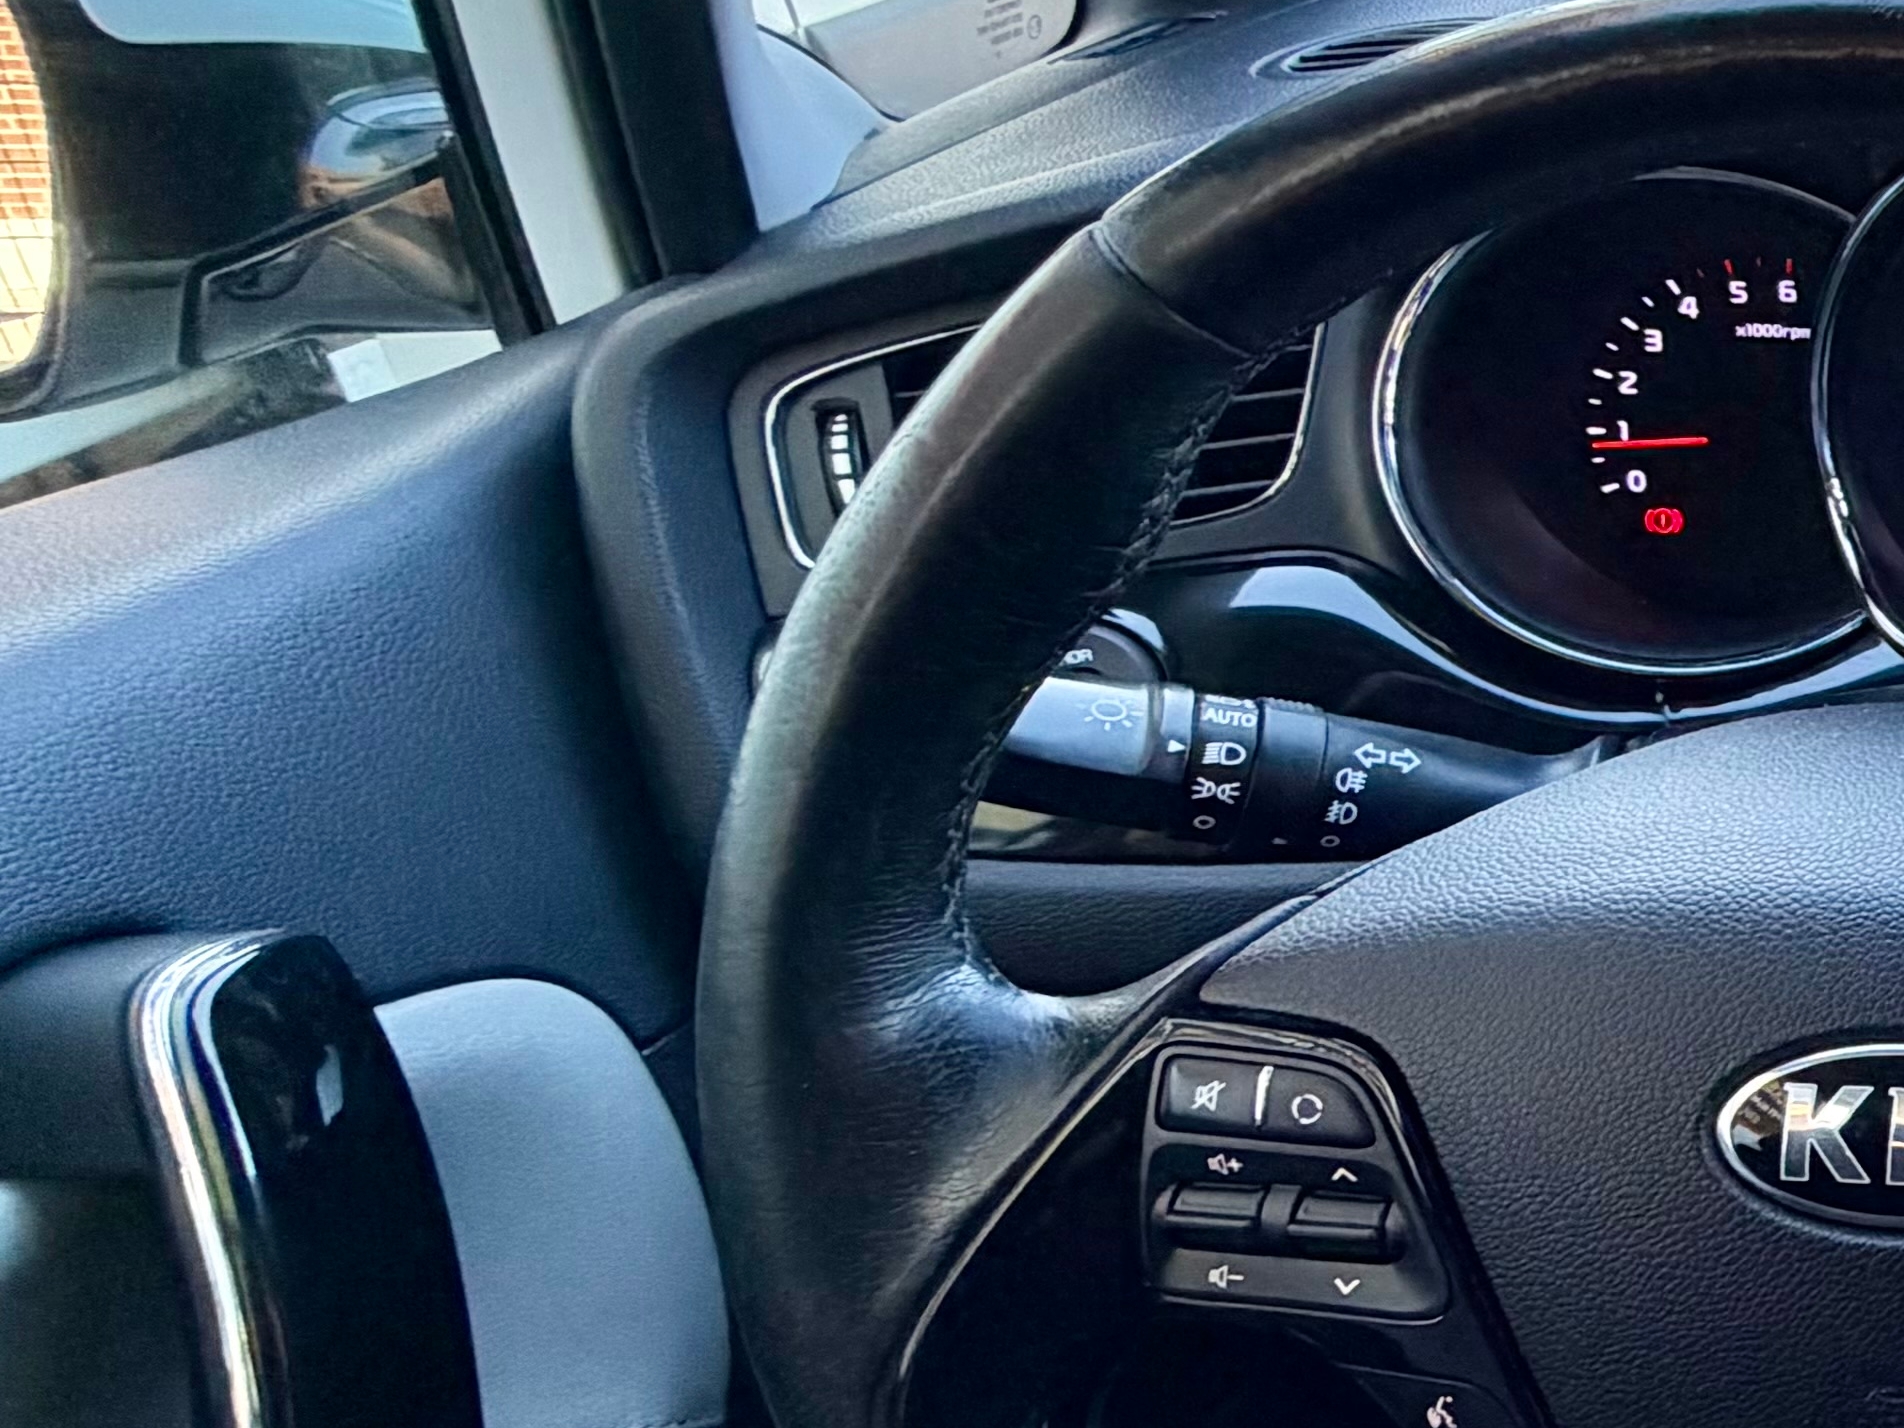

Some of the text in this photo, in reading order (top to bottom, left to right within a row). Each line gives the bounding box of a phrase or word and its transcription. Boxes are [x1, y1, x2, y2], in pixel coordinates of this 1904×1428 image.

[1729, 281, 1748, 303] 5
[1778, 281, 1797, 303] 6
[1678, 296, 1699, 319] 4
[1644, 329, 1664, 352] 3
[1735, 323, 1811, 342] x1000rpm
[1618, 371, 1639, 395] 2
[1616, 420, 1630, 442] 1
[1626, 470, 1647, 492] 0
[1202, 709, 1257, 728] AUTO
